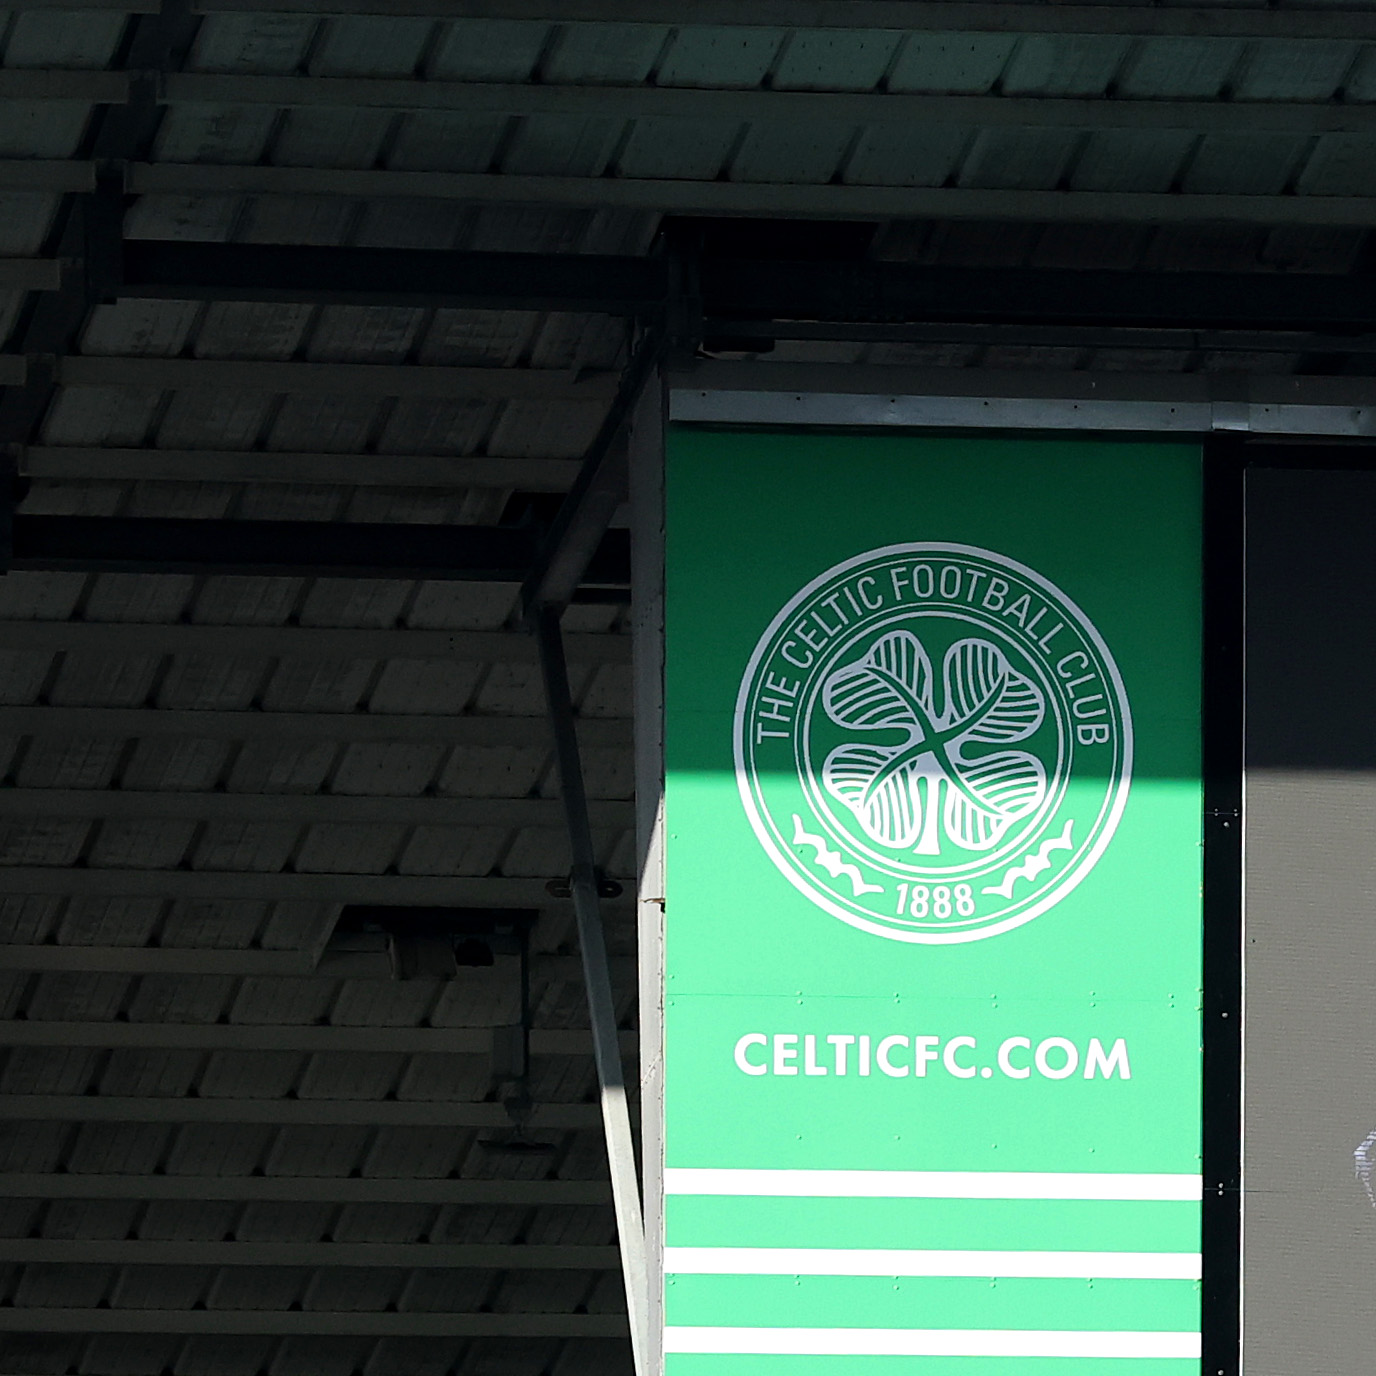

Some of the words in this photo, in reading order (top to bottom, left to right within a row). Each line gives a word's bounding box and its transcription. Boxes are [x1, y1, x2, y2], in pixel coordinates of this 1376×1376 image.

[757, 671, 801, 745] THE
[782, 575, 885, 669] CELTIC
[890, 563, 1067, 655] FOOTBALL
[1055, 650, 1110, 747] CLUB
[896, 883, 976, 918] 1888
[733, 1032, 1132, 1080] CELTICFC.COM
